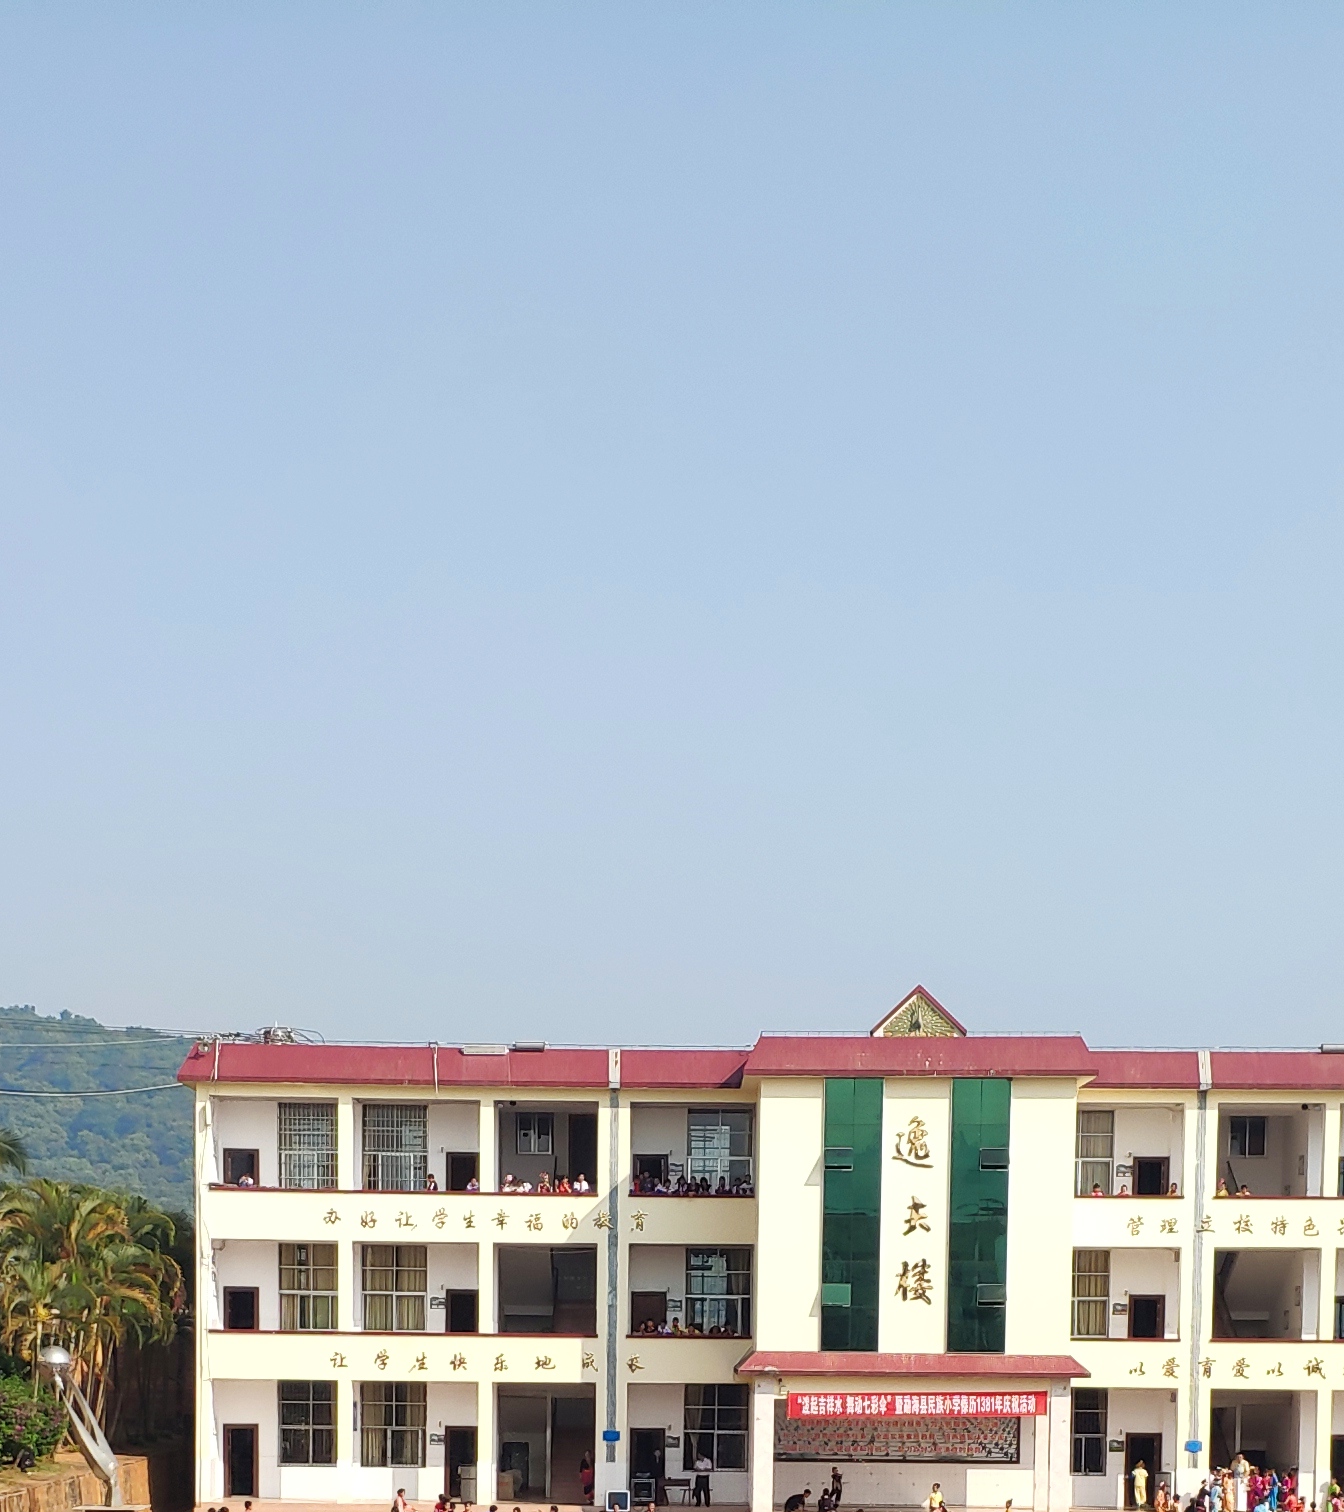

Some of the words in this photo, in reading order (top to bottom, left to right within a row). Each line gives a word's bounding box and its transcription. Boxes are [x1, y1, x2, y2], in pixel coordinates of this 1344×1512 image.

[322, 1207, 650, 1233] 办好让学生幸福的教育
[329, 1349, 646, 1373] 让学生快乐地成长
